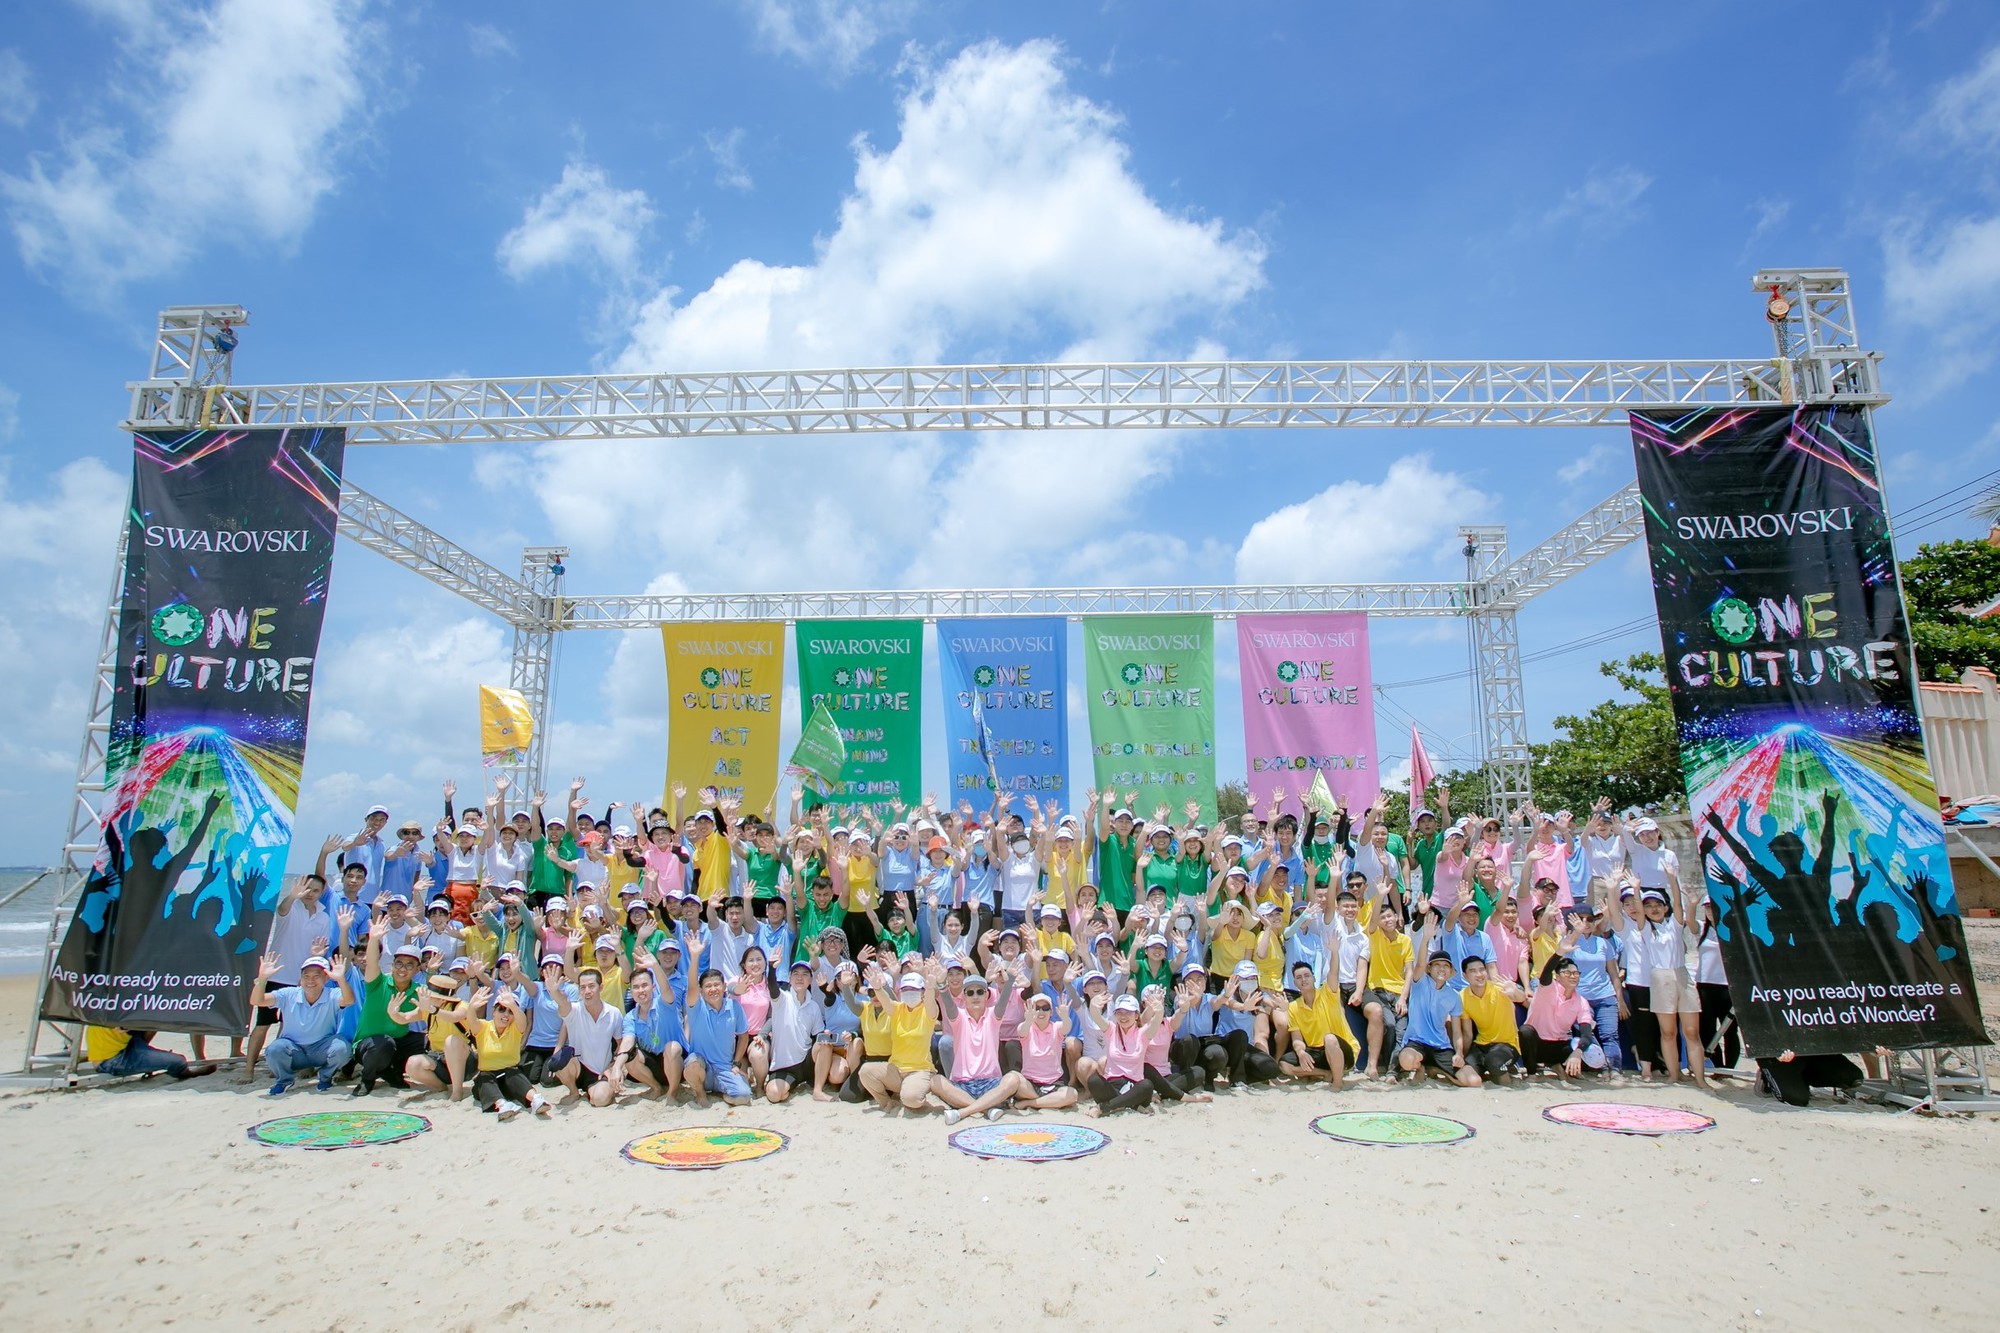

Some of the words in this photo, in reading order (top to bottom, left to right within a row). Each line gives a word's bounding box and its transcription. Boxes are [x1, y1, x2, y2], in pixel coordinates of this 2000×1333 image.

[1677, 507, 1853, 540] SWAROVSKI
[145, 526, 309, 552] SWAROVSKI
[151, 603, 278, 649] ONE
[1711, 592, 1838, 644] ONE
[678, 641, 773, 656] SWAROVSKI
[810, 638, 911, 655] SWAROVSKI
[952, 637, 1054, 652] SWAROVSKI
[1098, 635, 1201, 651] SWAROVSKI
[1253, 632, 1356, 648] SWAROVSKI
[1121, 662, 1179, 686] ONE
[1276, 660, 1335, 683] ONE
[1678, 641, 1900, 688] CULTURE
[701, 667, 753, 689] ONE
[832, 667, 888, 689] ONE
[973, 664, 1032, 688] ONE
[683, 692, 772, 712] CULTURE
[1102, 688, 1202, 708] CULTURE
[1258, 685, 1359, 705] CULTURE
[710, 727, 751, 746] ACT
[838, 728, 884, 741] RAND
[959, 738, 1036, 757] TRSTED
[1253, 755, 1368, 772] EXPLORATIVE
[1112, 772, 1198, 786] ACHIEVING
[52, 965, 78, 983] Are
[113, 970, 161, 991] ready
[164, 972, 180, 987] to
[183, 972, 230, 987] create
[233, 975, 242, 987] a
[121, 992, 140, 1010] of
[143, 993, 215, 1011] Wonder?
[1751, 985, 1781, 1002] Are
[1783, 988, 1816, 1006] you
[1818, 981, 1866, 1003] ready
[1868, 983, 1886, 998] to
[1889, 981, 1944, 997] create
[1949, 983, 1962, 995] a
[1781, 1006, 1837, 1027] World
[1839, 1005, 1856, 1024] of
[1858, 1003, 1936, 1024] Wonder?
